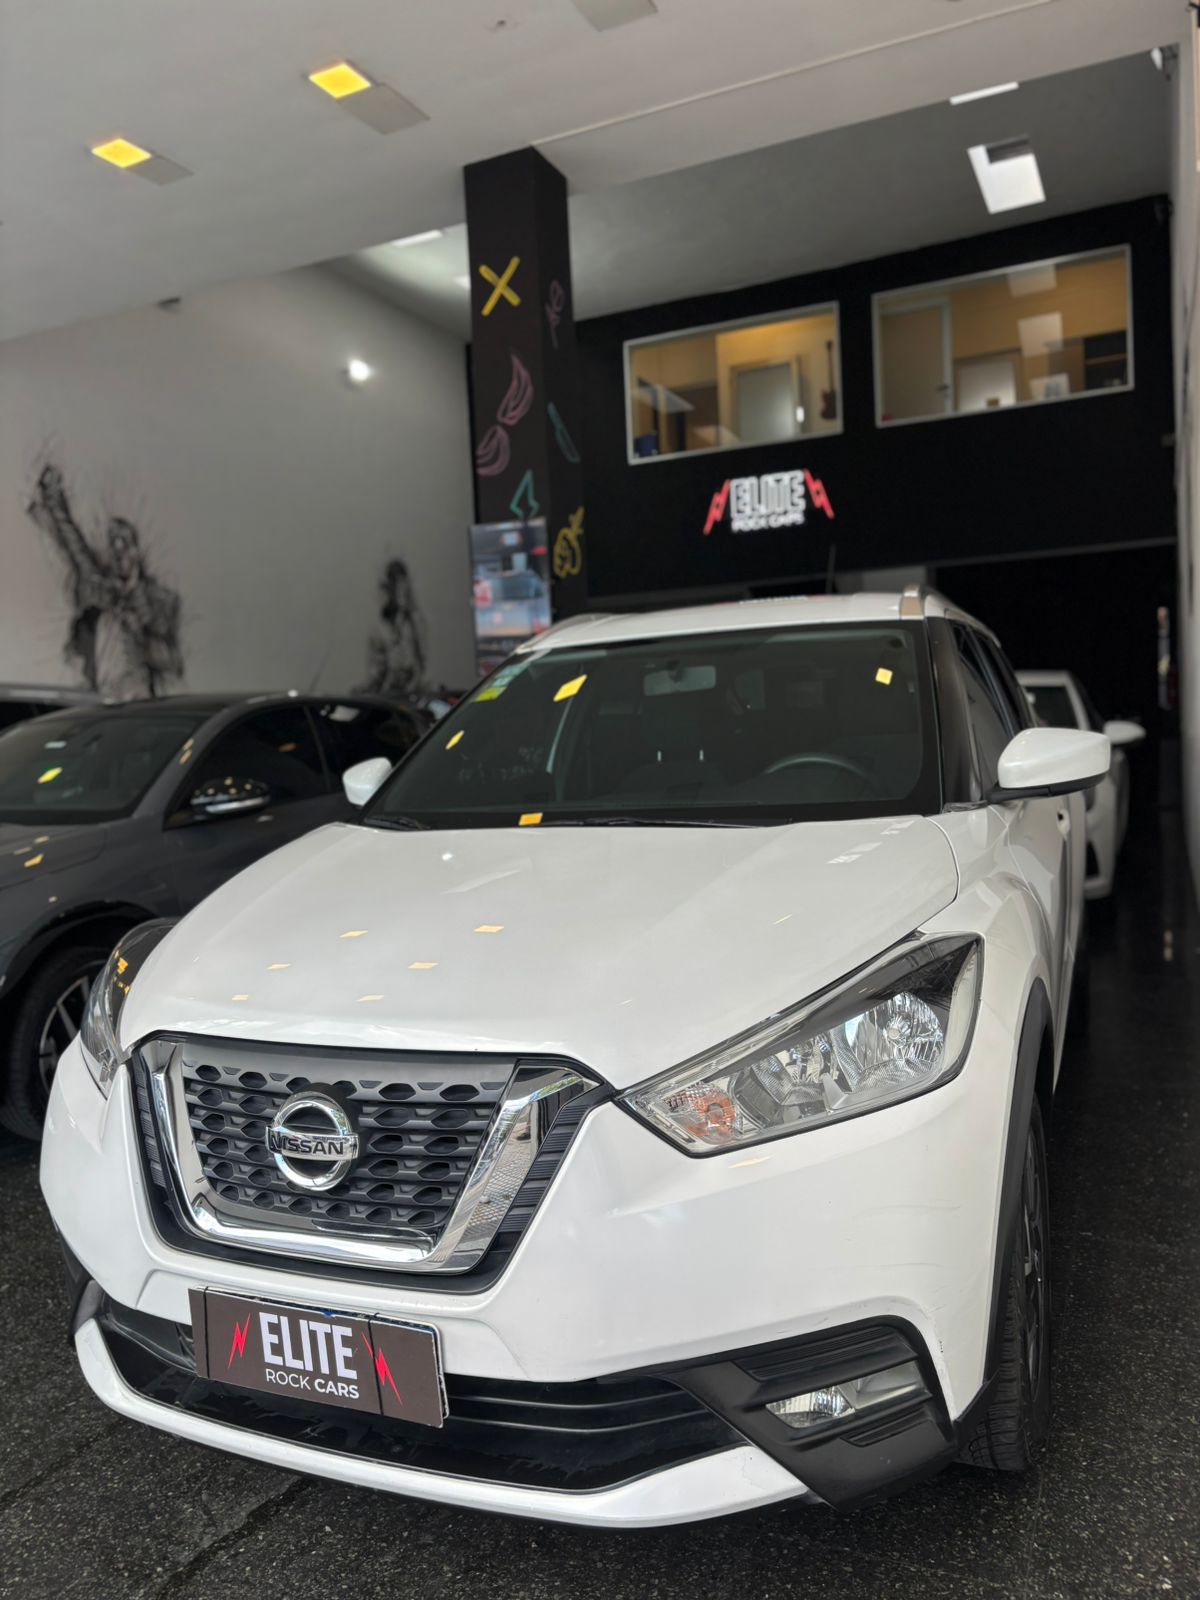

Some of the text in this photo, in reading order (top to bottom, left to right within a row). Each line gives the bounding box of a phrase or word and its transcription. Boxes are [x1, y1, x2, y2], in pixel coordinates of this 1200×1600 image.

[730, 469, 806, 519] ELITE
[268, 1131, 344, 1155] NISSAN
[259, 1312, 357, 1379] ELITE
[265, 1368, 360, 1399] ROCK CARS
